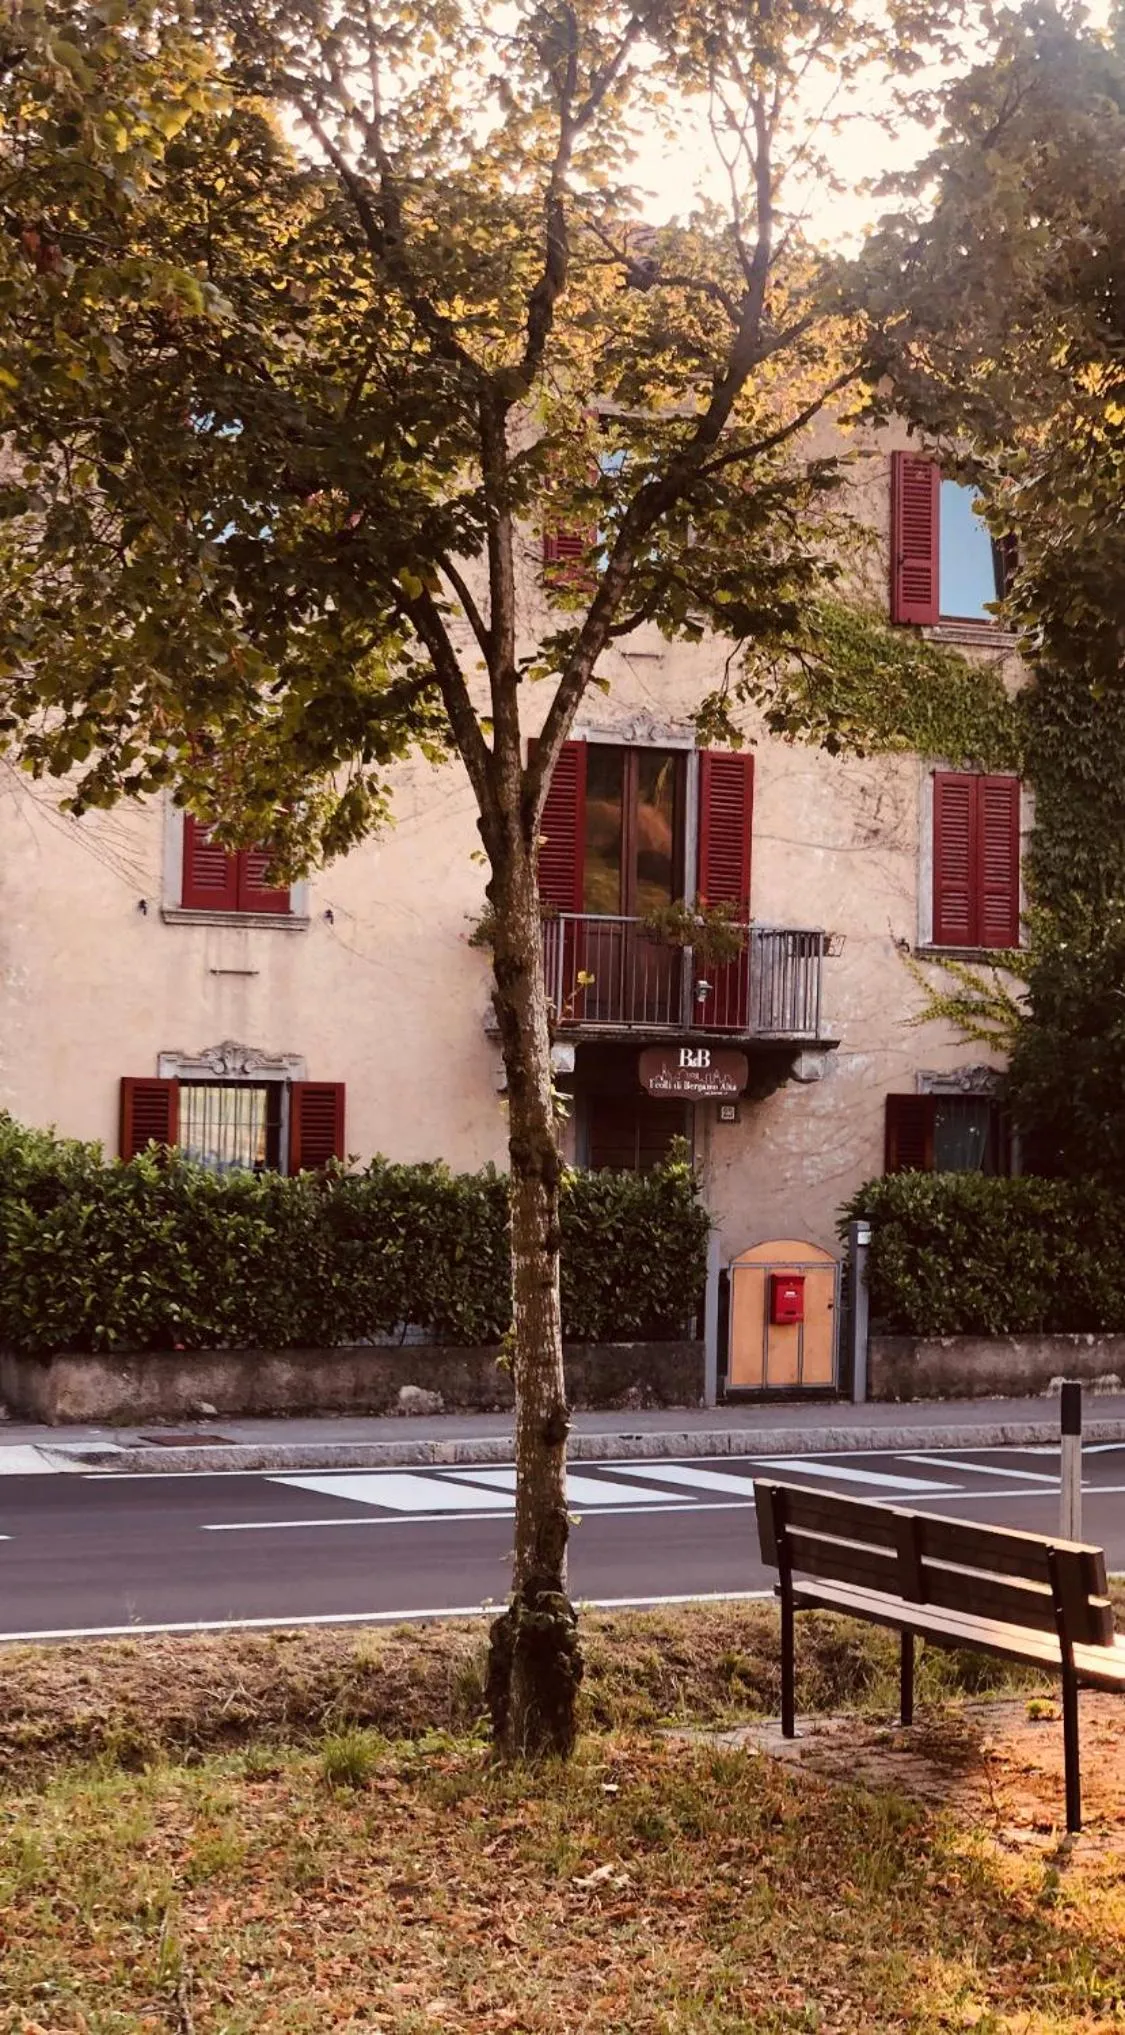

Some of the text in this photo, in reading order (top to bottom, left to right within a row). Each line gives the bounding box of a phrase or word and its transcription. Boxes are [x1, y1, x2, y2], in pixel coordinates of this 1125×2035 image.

[679, 1048, 711, 1068] B&B
[683, 1080, 719, 1092] Bergamo
[720, 1082, 737, 1091] Alta
